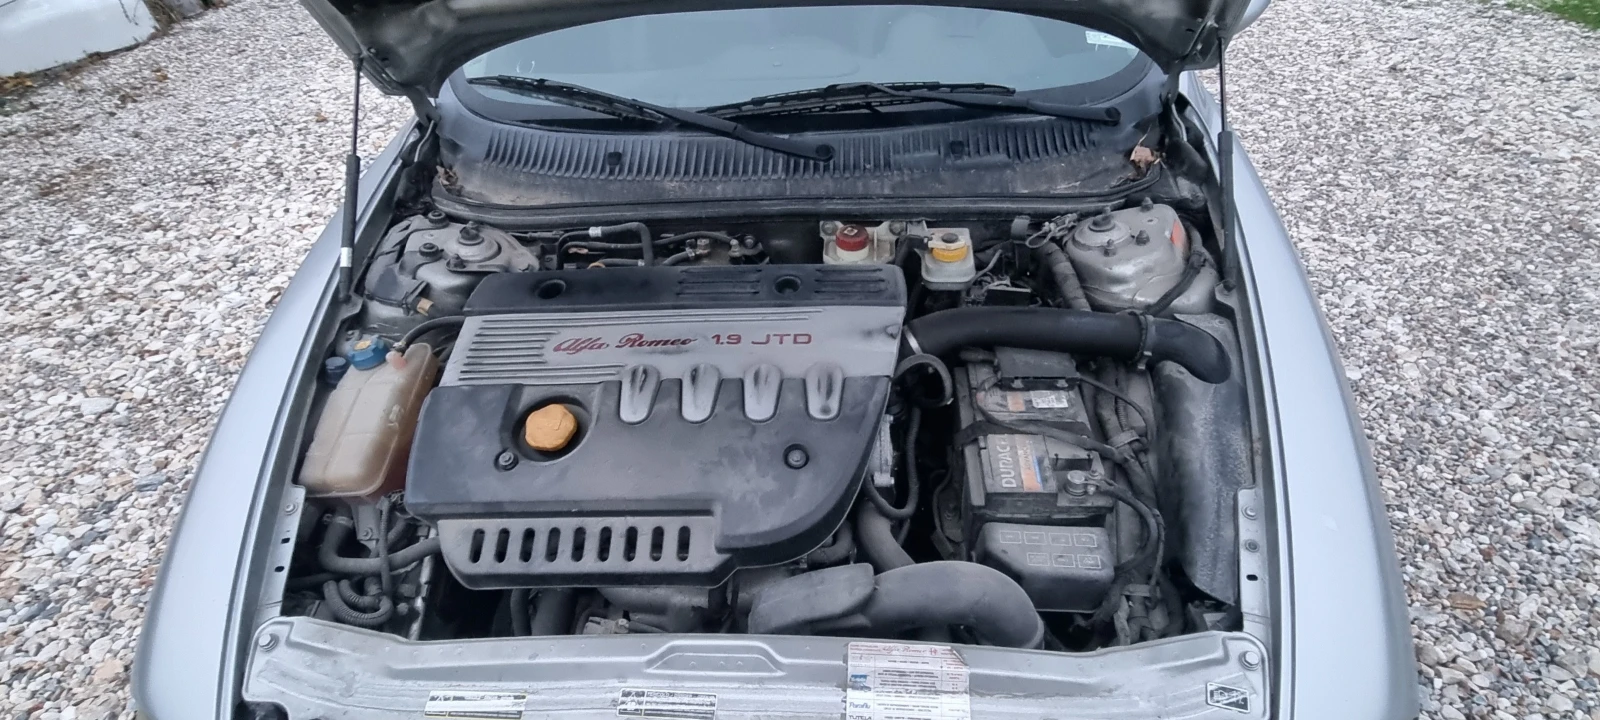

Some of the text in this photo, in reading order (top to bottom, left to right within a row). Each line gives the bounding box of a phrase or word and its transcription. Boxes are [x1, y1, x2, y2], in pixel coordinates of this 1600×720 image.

[553, 332, 812, 355] Alfa Romeo 1.9 JTD
[997, 434, 1017, 487] DURAC
